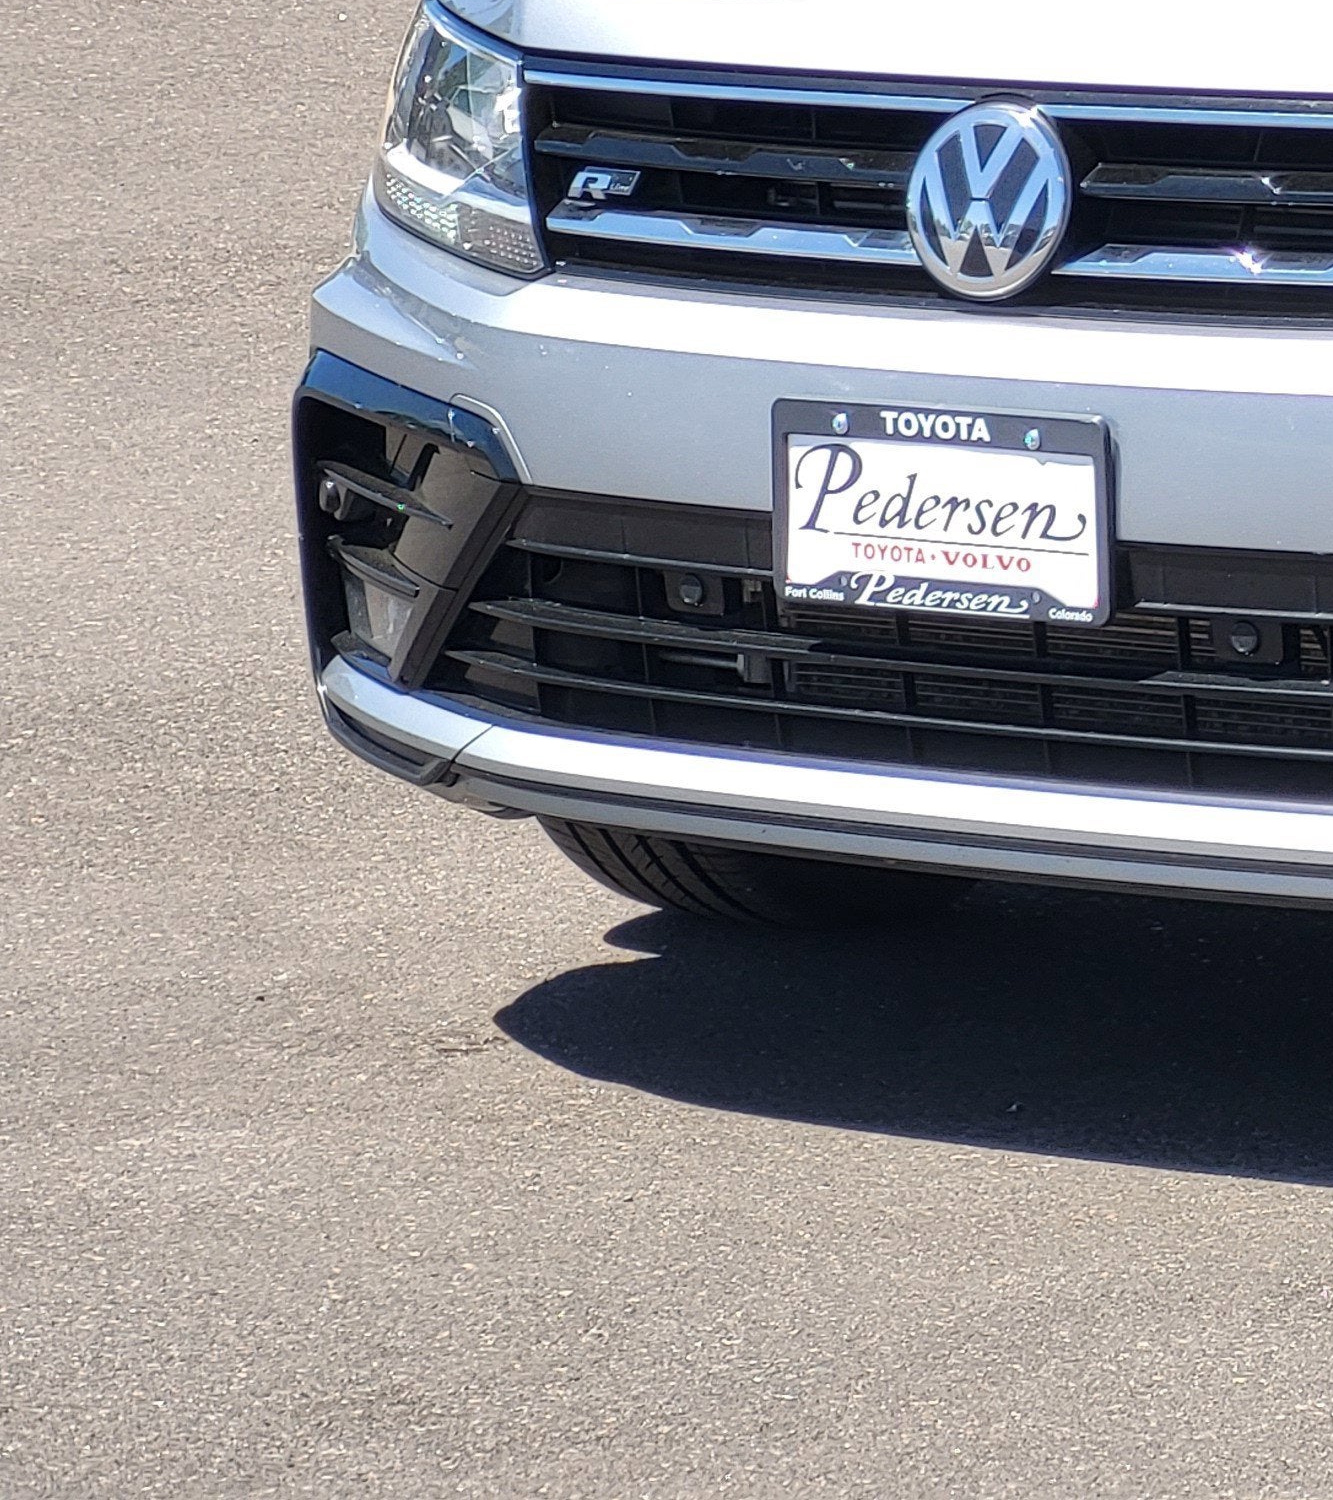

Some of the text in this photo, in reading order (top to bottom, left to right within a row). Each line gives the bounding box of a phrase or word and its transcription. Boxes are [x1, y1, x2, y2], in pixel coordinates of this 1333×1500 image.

[567, 171, 612, 199] R
[880, 410, 991, 442] TOYOTA
[795, 443, 1087, 541] Pedersen
[851, 542, 1031, 572] TOYOTA VOLVO
[785, 585, 844, 601] Fort Collins
[850, 571, 1029, 613] Pedersen
[1048, 607, 1093, 623] Colorado
